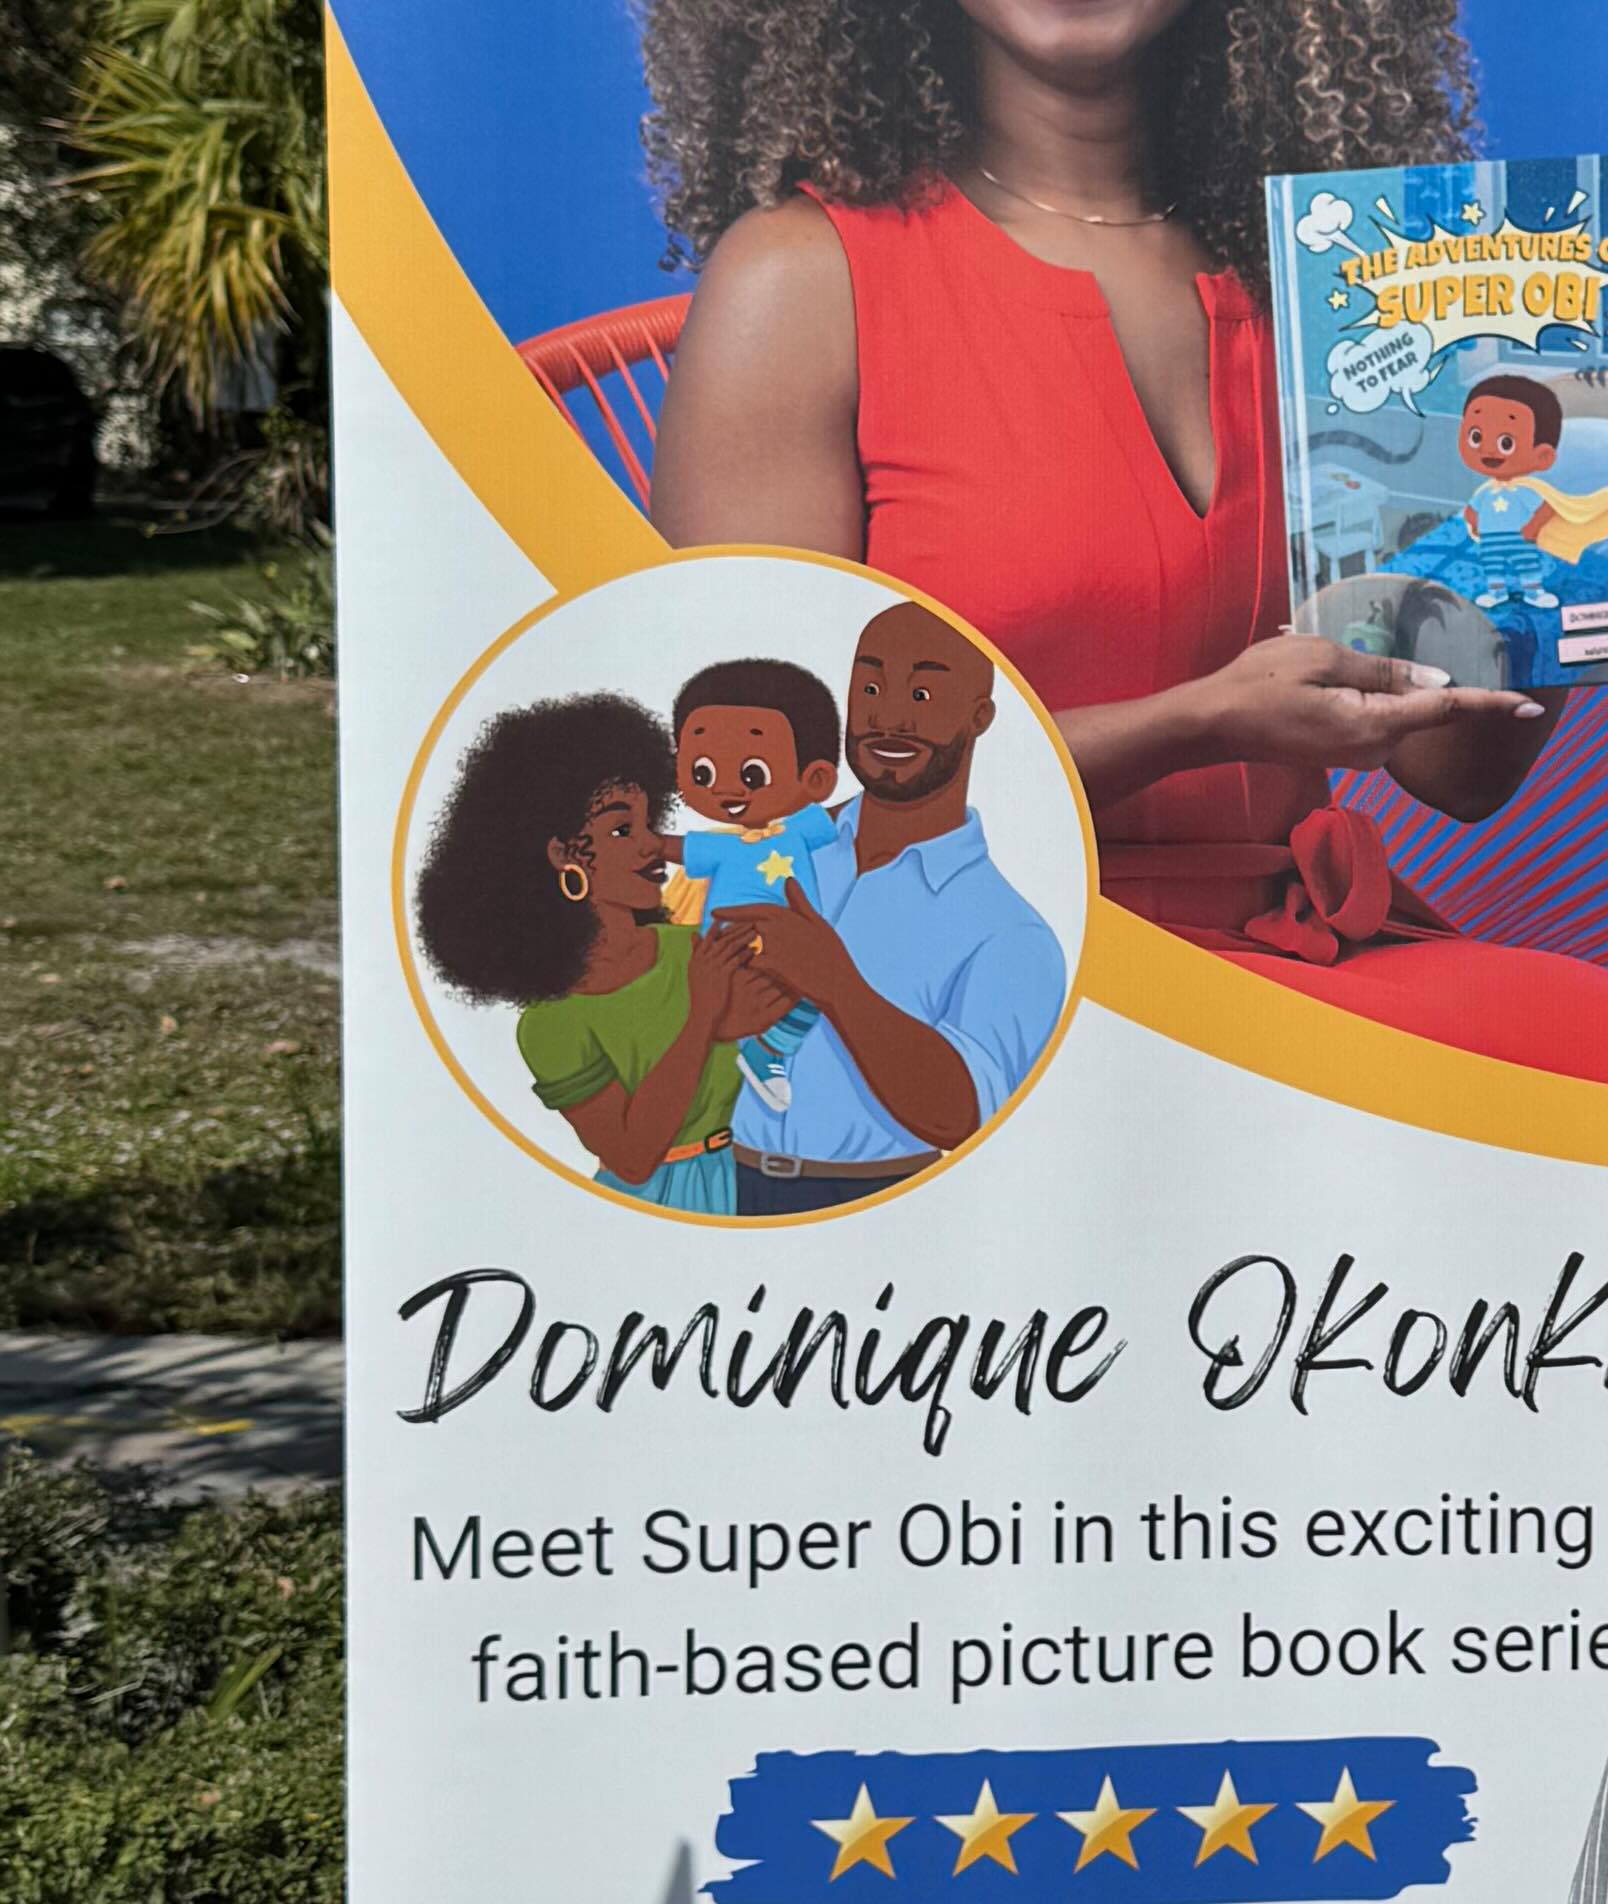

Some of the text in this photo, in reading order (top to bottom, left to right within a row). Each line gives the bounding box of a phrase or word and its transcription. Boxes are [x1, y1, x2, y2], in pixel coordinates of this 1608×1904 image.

[1341, 248, 1398, 286] THE
[1404, 233, 1591, 270] ADVENTURES
[1376, 271, 1600, 329] SUPER OBI
[1343, 332, 1414, 382] NOTHING
[1356, 351, 1419, 393] TO FEAR
[397, 1269, 1125, 1456] Dominique
[412, 1514, 614, 1582] Meet
[643, 1509, 871, 1591] Super
[900, 1499, 1021, 1568] Obi
[1055, 1500, 1113, 1564] in
[1140, 1494, 1277, 1562] this
[1306, 1492, 1593, 1570] exciting
[471, 1621, 922, 1703] faith-based
[952, 1622, 1213, 1705] picture
[1243, 1609, 1426, 1678] book
